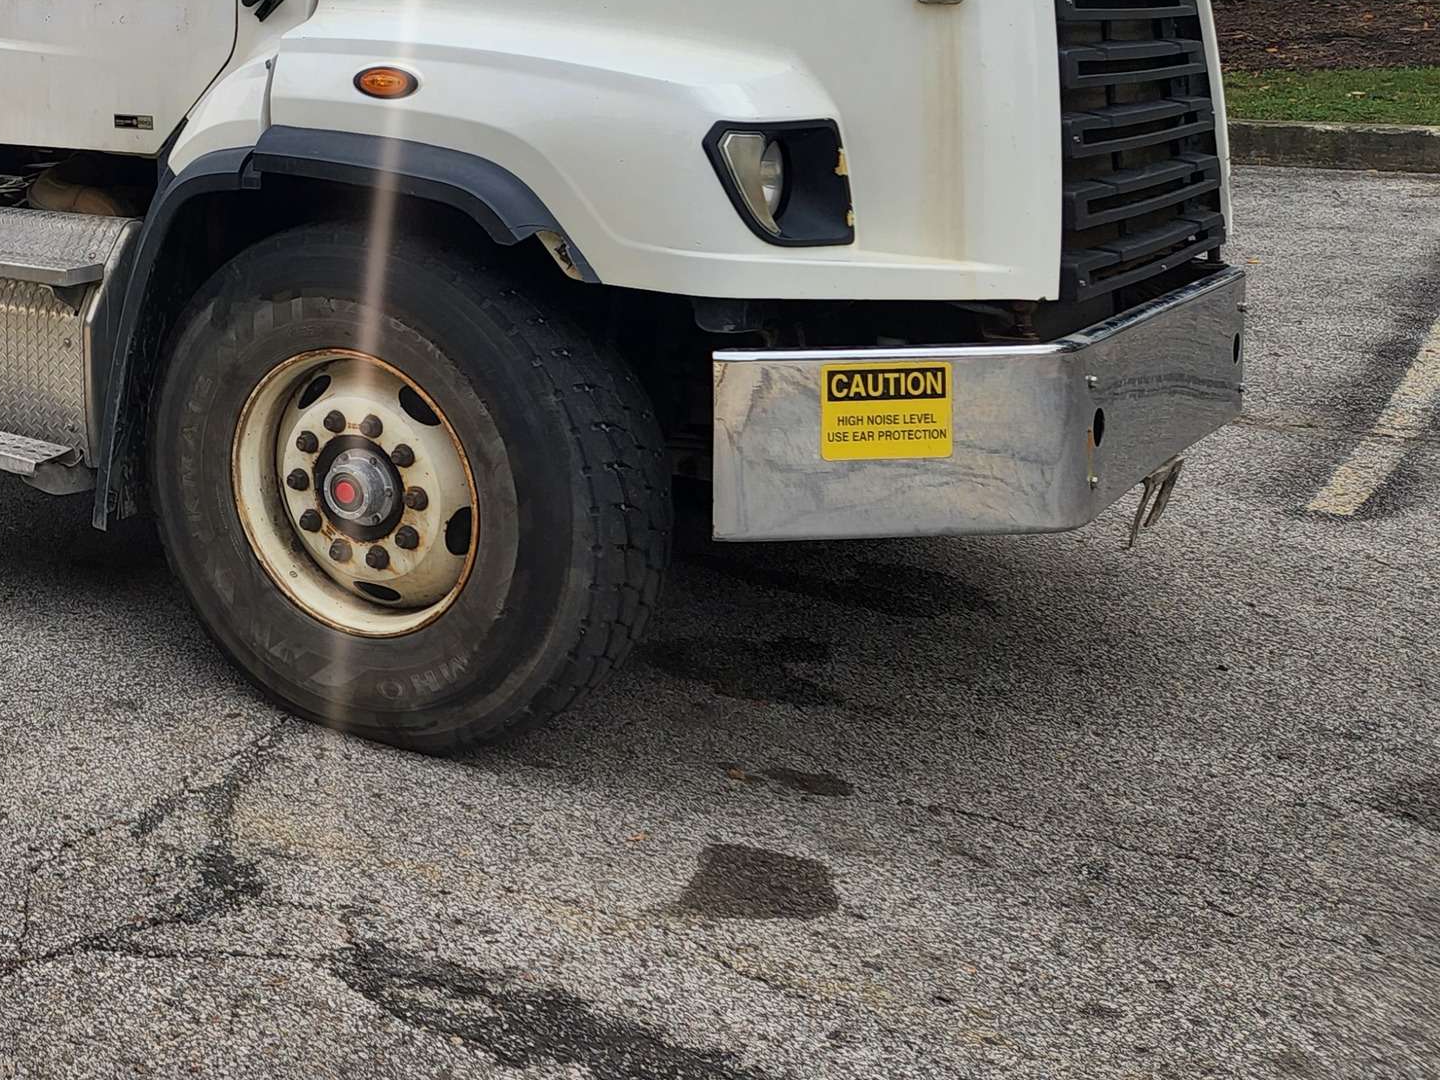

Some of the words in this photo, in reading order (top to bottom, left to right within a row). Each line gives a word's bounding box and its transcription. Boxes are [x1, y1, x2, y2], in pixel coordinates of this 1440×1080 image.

[830, 371, 943, 399] CAUTION
[837, 415, 864, 427] HIGH
[866, 414, 900, 426] NOISE
[903, 413, 937, 425] LEVEL
[827, 431, 849, 443] USE
[852, 430, 875, 442] EAR
[878, 428, 947, 442] PROTECTION
